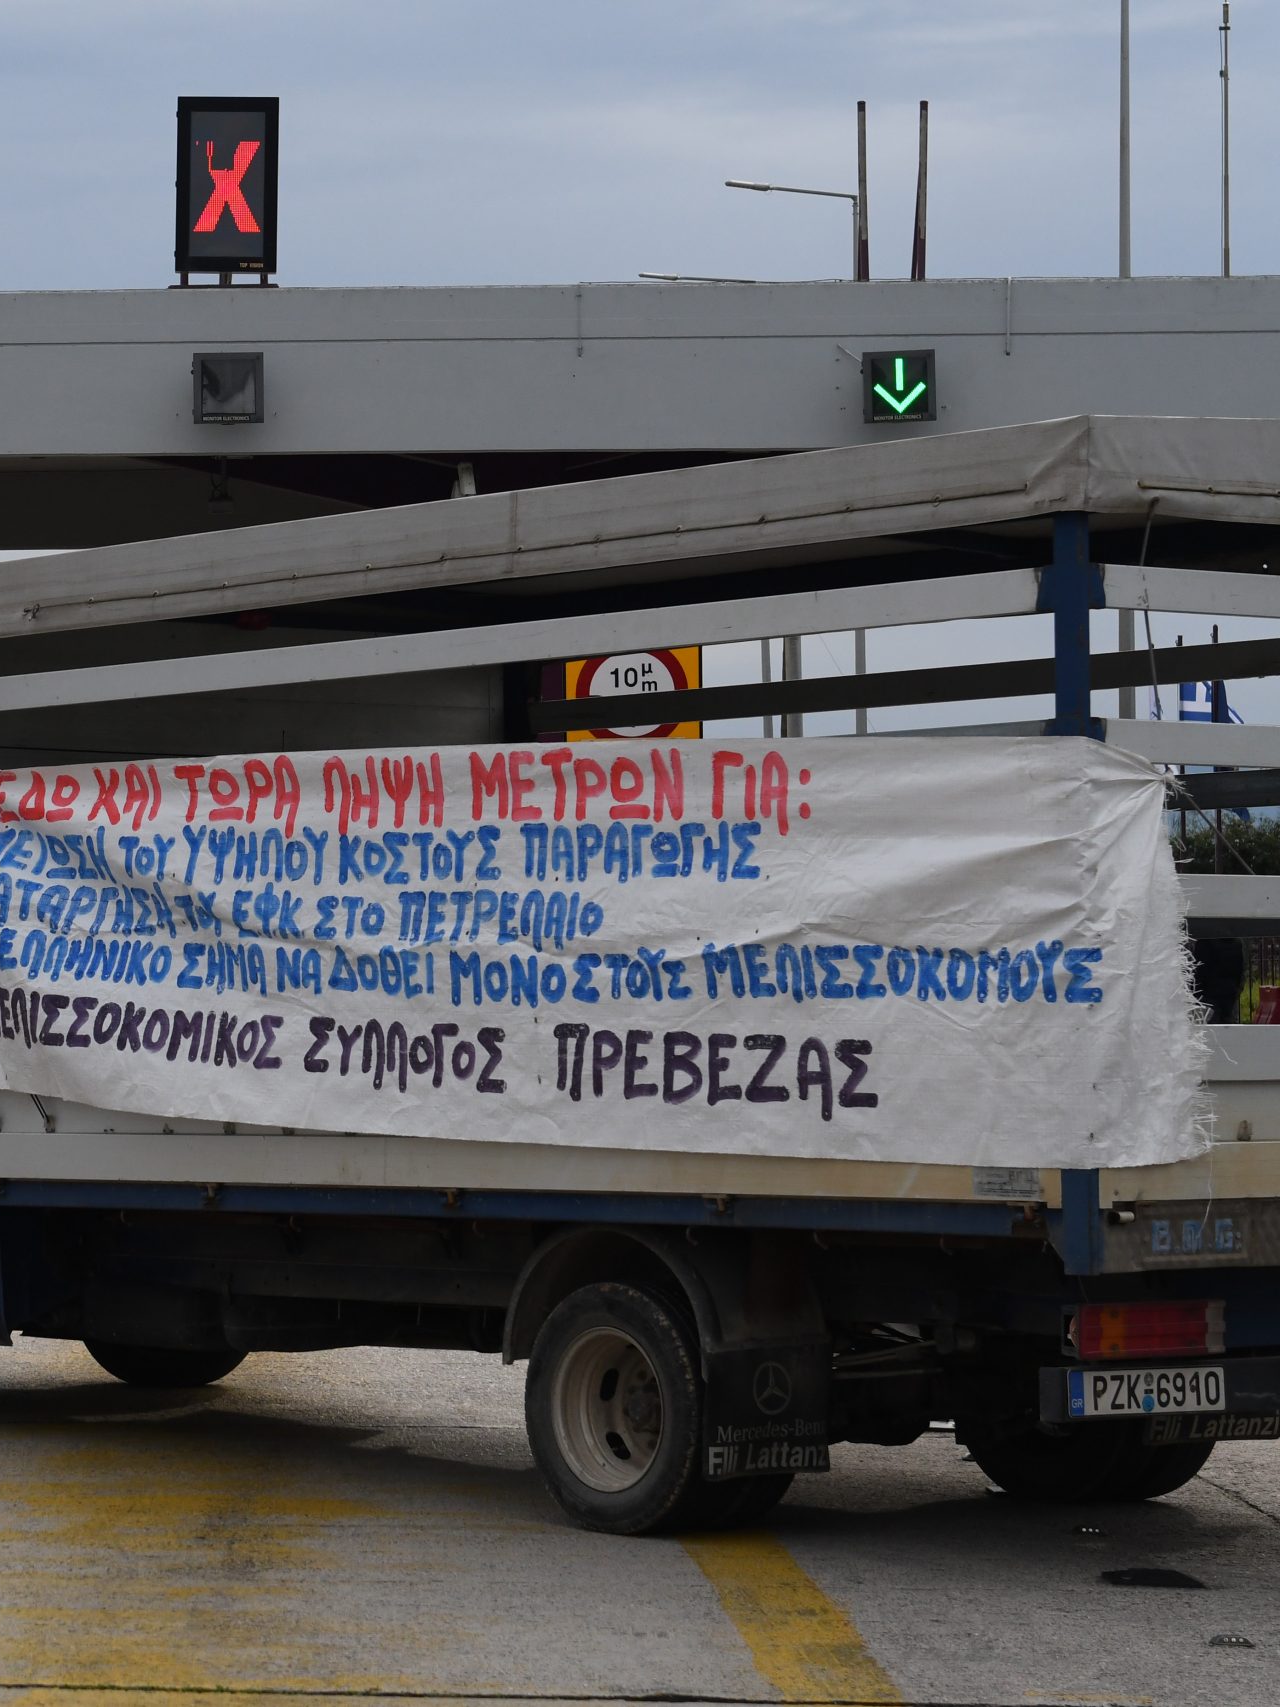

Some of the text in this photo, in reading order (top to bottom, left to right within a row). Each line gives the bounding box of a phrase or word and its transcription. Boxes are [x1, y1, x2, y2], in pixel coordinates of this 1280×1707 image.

[610, 667, 638, 688] 10
[641, 680, 658, 691] m
[173, 754, 301, 838] ΤΩΡΑ
[469, 748, 685, 822] ΜΕΤΡΩΝ
[711, 750, 812, 835] ΓΙΑ:
[339, 825, 501, 884] ΚΟΣΤΟΥΣ
[520, 821, 762, 882] ΠΑΡΑΓΩΓΗΣ
[232, 882, 304, 939] ΕΦΚ
[313, 891, 385, 940] ΣΤΟ
[176, 942, 268, 995] ΣΗΜΑ
[276, 946, 321, 995] ΝΑ
[328, 944, 434, 999] ΔΟΘΕΙ
[450, 950, 567, 1007] ΜΟΝΟ
[572, 946, 693, 1003] ΣΤΟΥΣ
[554, 1022, 880, 1121] ΠΡΕΒΕΖΑΣ
[717, 1418, 826, 1443] Mercedes-Ben
[1071, 1398, 1084, 1409] GR
